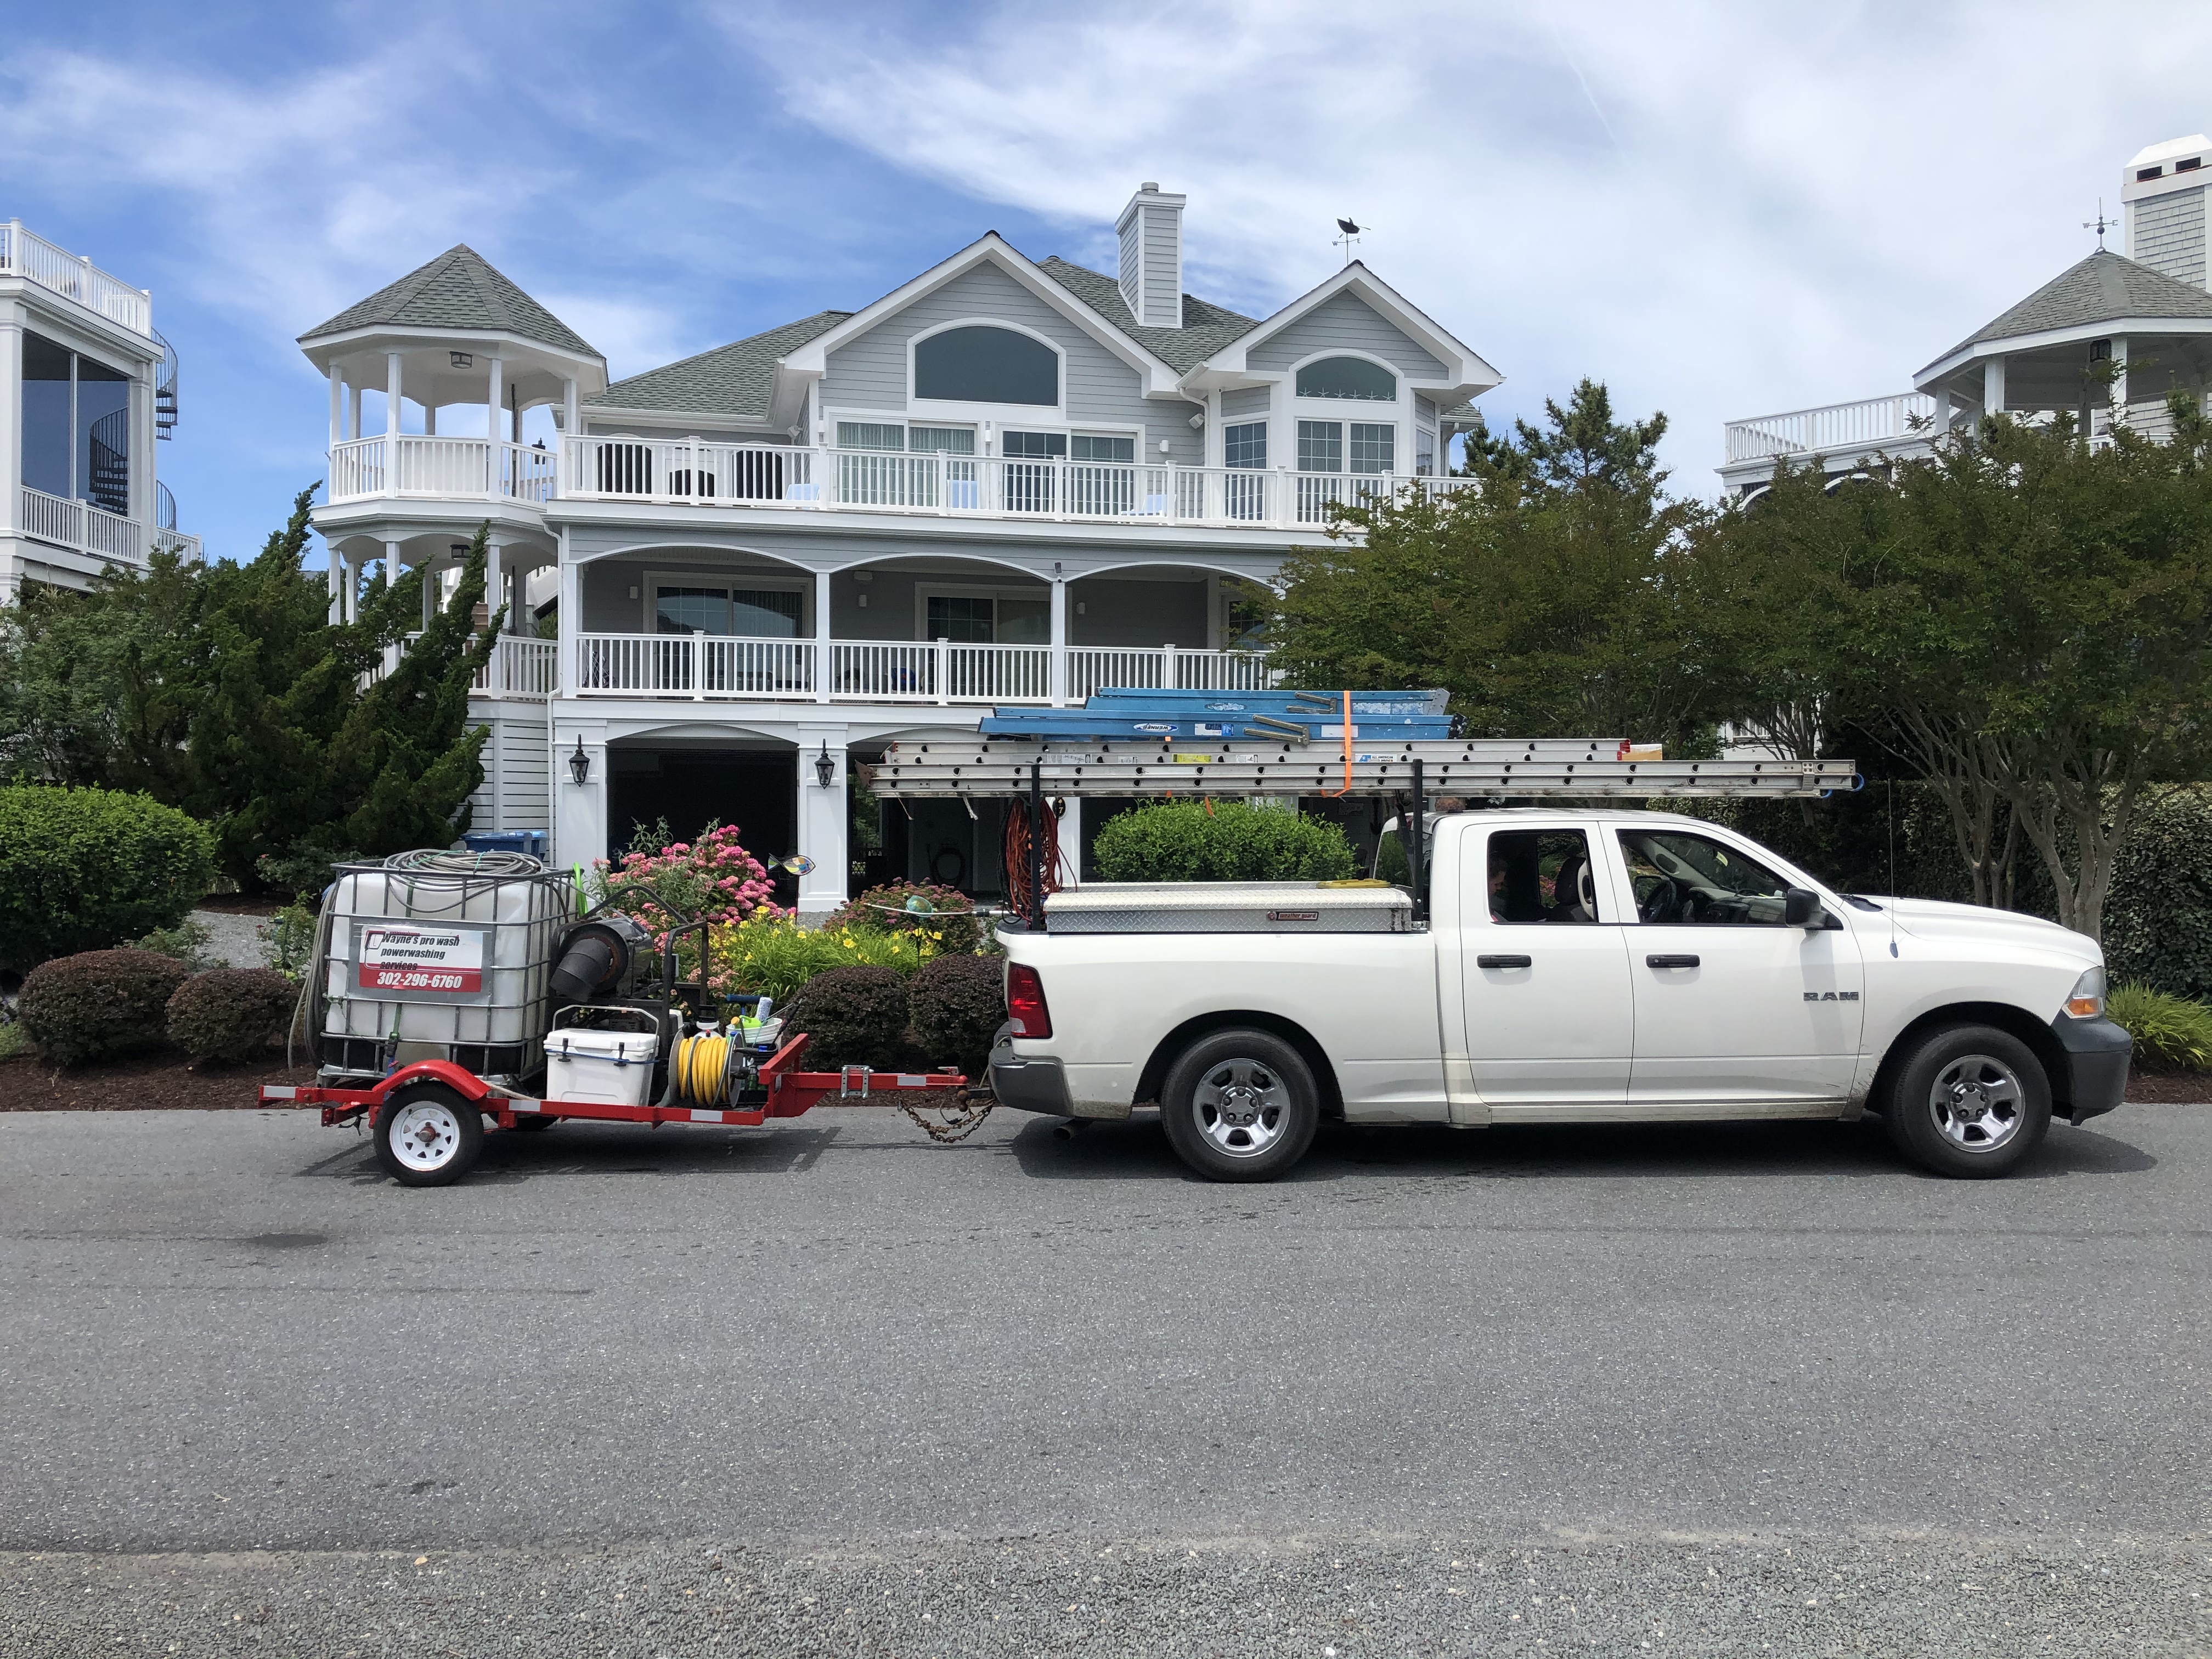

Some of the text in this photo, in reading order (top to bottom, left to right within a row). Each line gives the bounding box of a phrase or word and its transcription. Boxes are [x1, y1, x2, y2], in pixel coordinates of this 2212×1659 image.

[382, 933, 418, 944] Wayne's
[419, 937, 435, 946] pro
[436, 936, 459, 946] wash
[380, 948, 445, 960] powerwashing
[380, 961, 417, 970] services
[377, 972, 462, 989] 302-296-6760
[1803, 991, 1859, 1001] RAM
